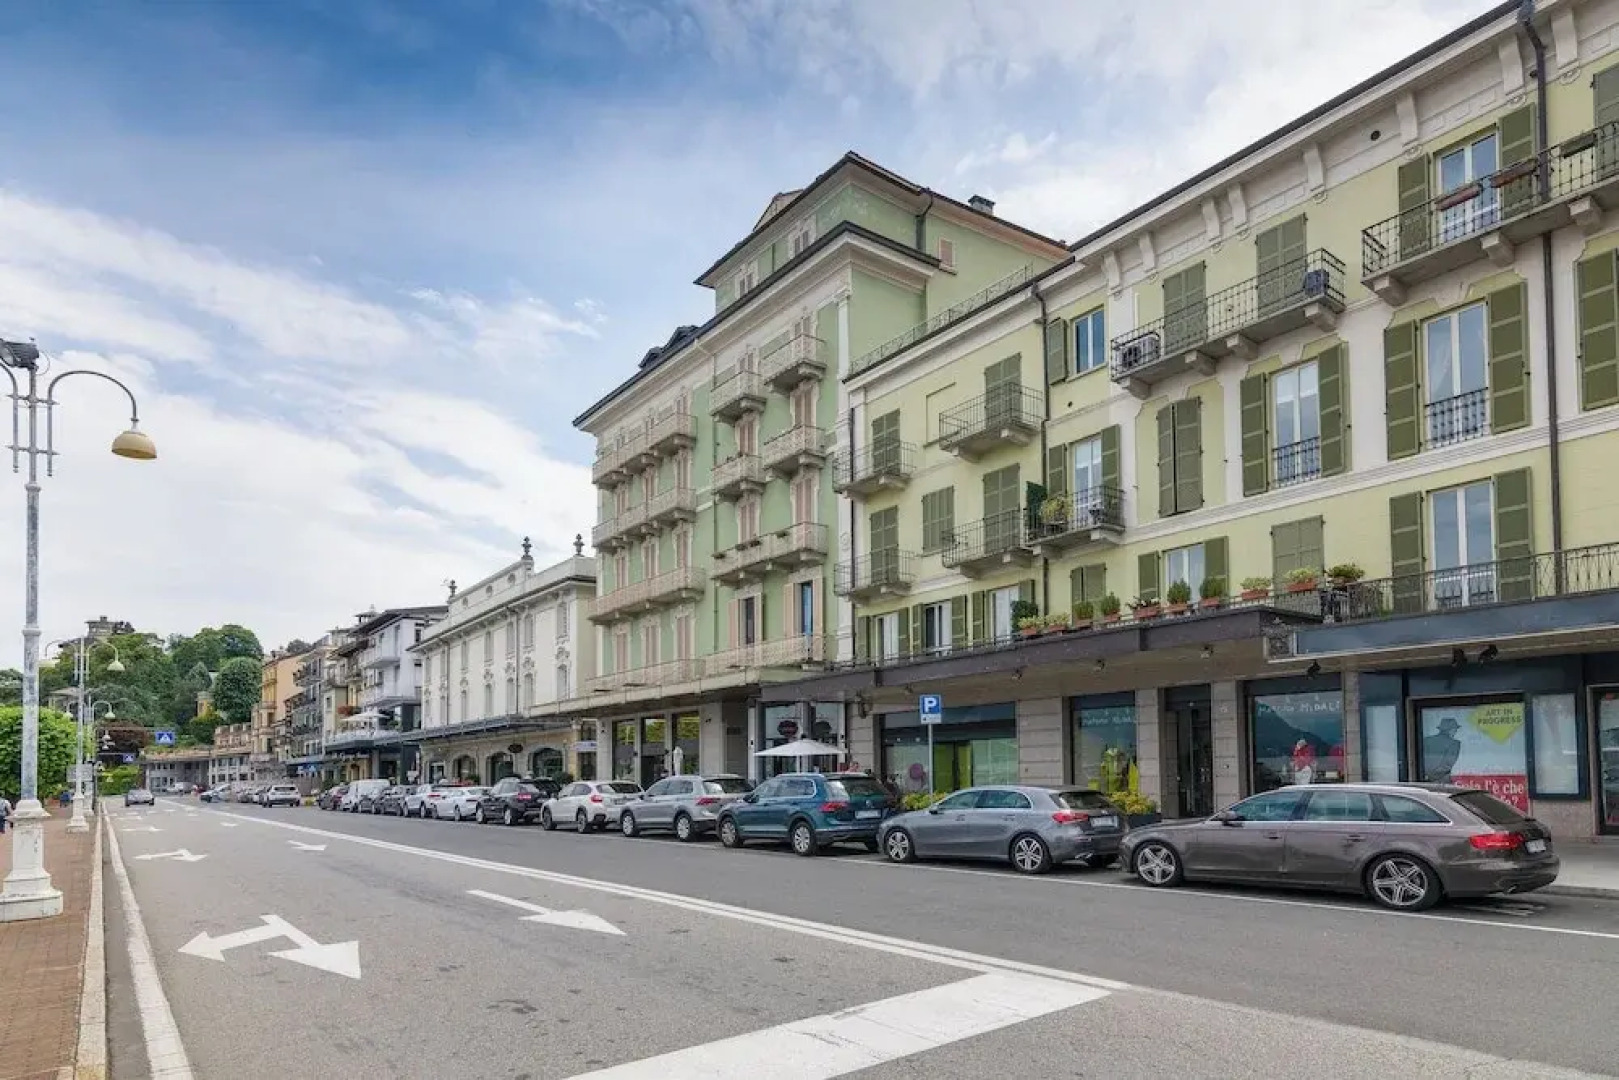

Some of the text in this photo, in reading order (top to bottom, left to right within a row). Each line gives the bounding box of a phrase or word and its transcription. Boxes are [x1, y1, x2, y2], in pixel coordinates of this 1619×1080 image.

[923, 697, 937, 712] P
[1477, 716, 1522, 725] PROGRESS
[1503, 780, 1523, 794] che
